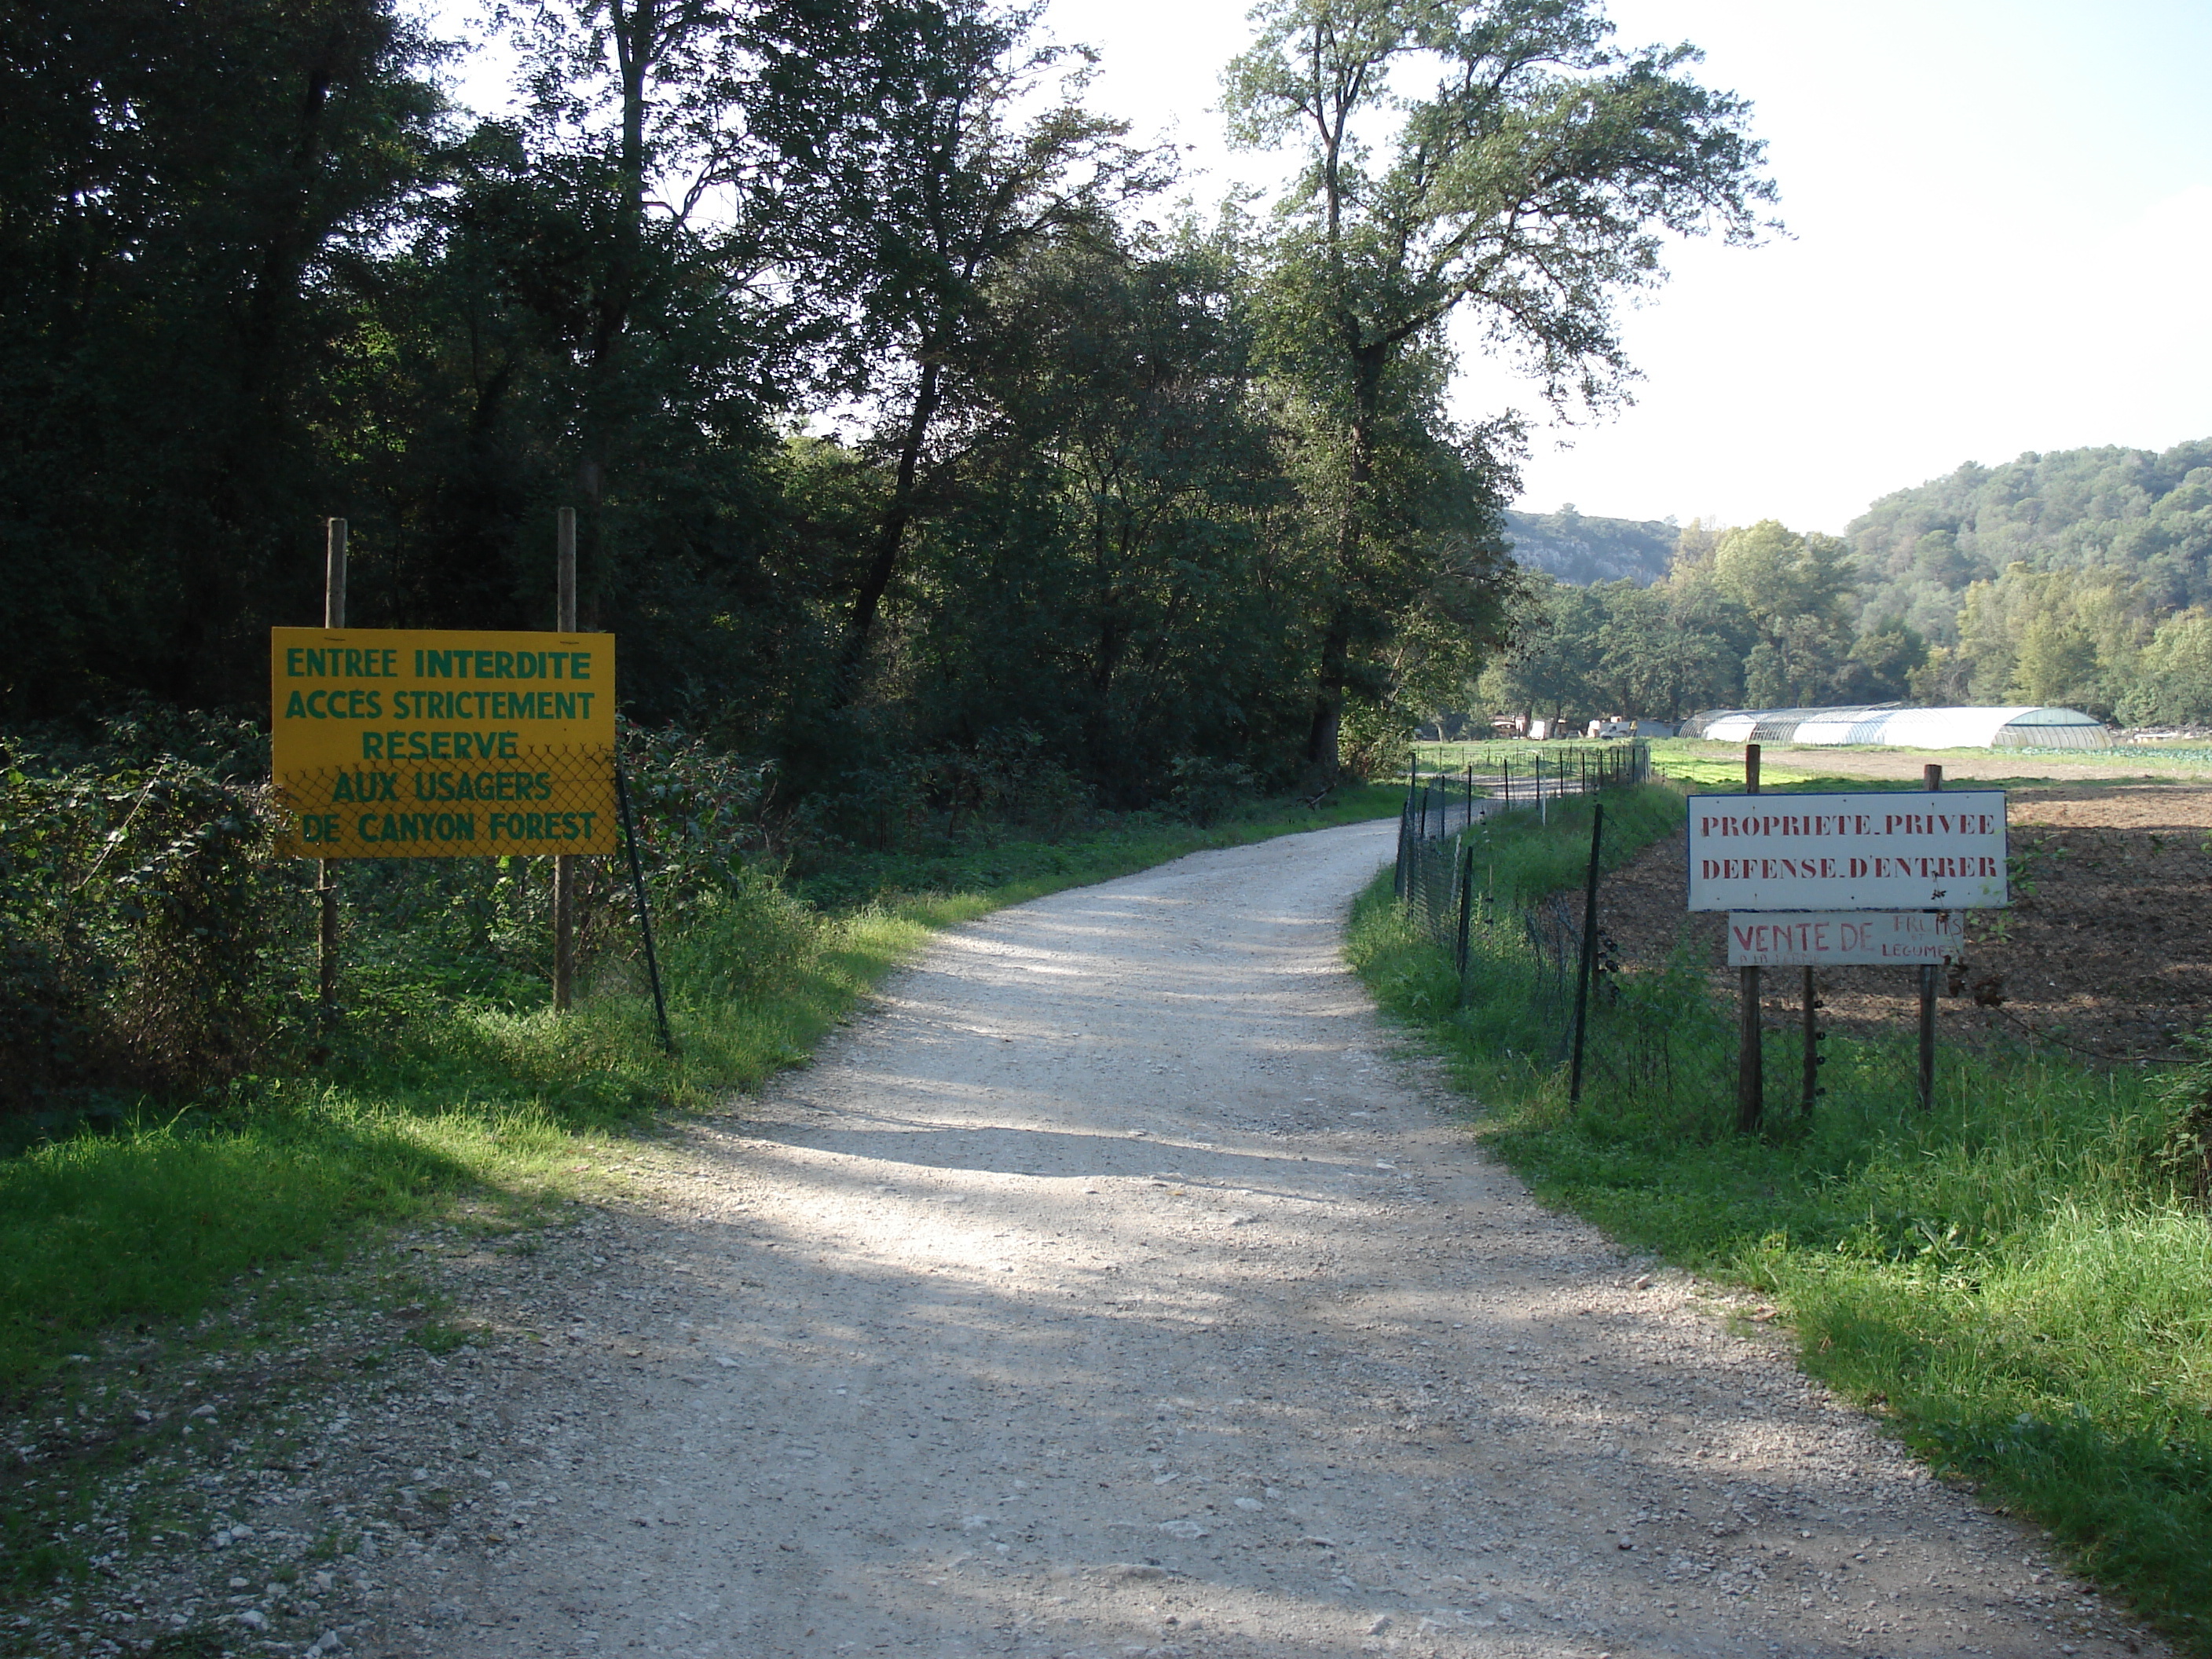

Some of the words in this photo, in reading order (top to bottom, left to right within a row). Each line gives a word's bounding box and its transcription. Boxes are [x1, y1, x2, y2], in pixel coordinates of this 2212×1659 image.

[287, 648, 397, 677] ENTREE
[415, 650, 591, 679] INTERDITE
[394, 690, 595, 719] STRICTEMENT
[332, 772, 399, 803] AUX
[416, 771, 551, 801] USAGERS
[303, 814, 341, 842] DE
[358, 813, 474, 842] CANYON
[490, 811, 597, 840] FOREST
[1734, 921, 1830, 953] VENTE
[1840, 922, 1875, 952] DE
